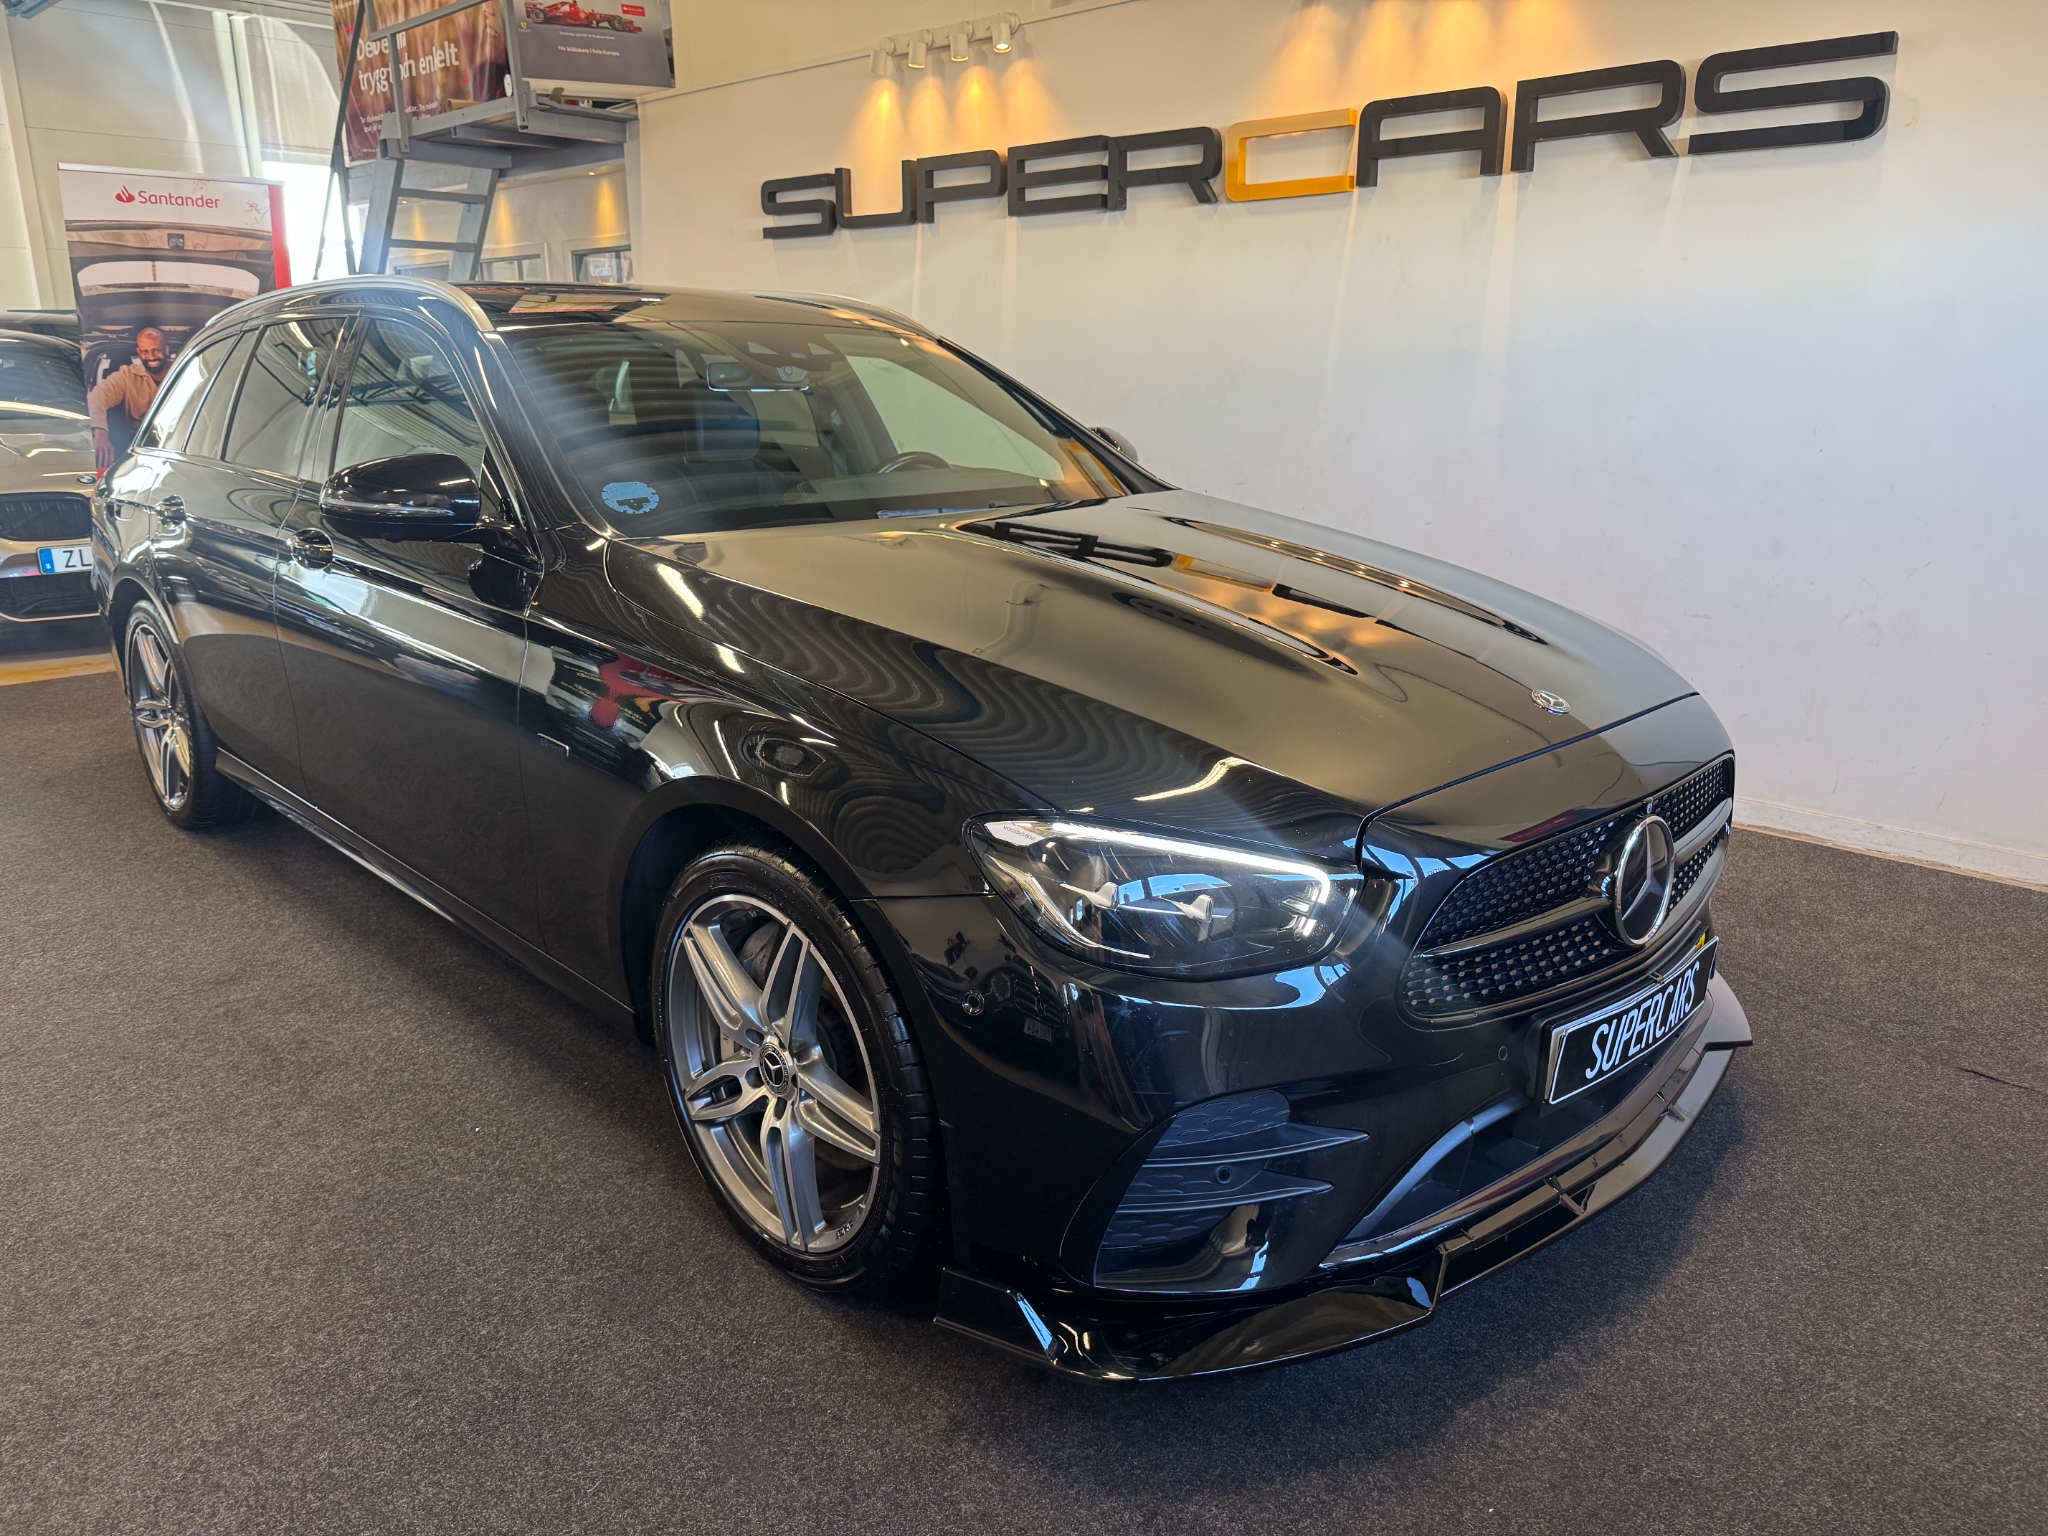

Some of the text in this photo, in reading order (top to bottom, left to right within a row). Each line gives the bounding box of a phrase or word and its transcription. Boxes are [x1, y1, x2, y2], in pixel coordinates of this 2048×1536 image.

[762, 30, 1899, 240] SUPERCARS
[138, 190, 221, 209] Santander
[1585, 960, 1700, 1080] SUPERCARS
